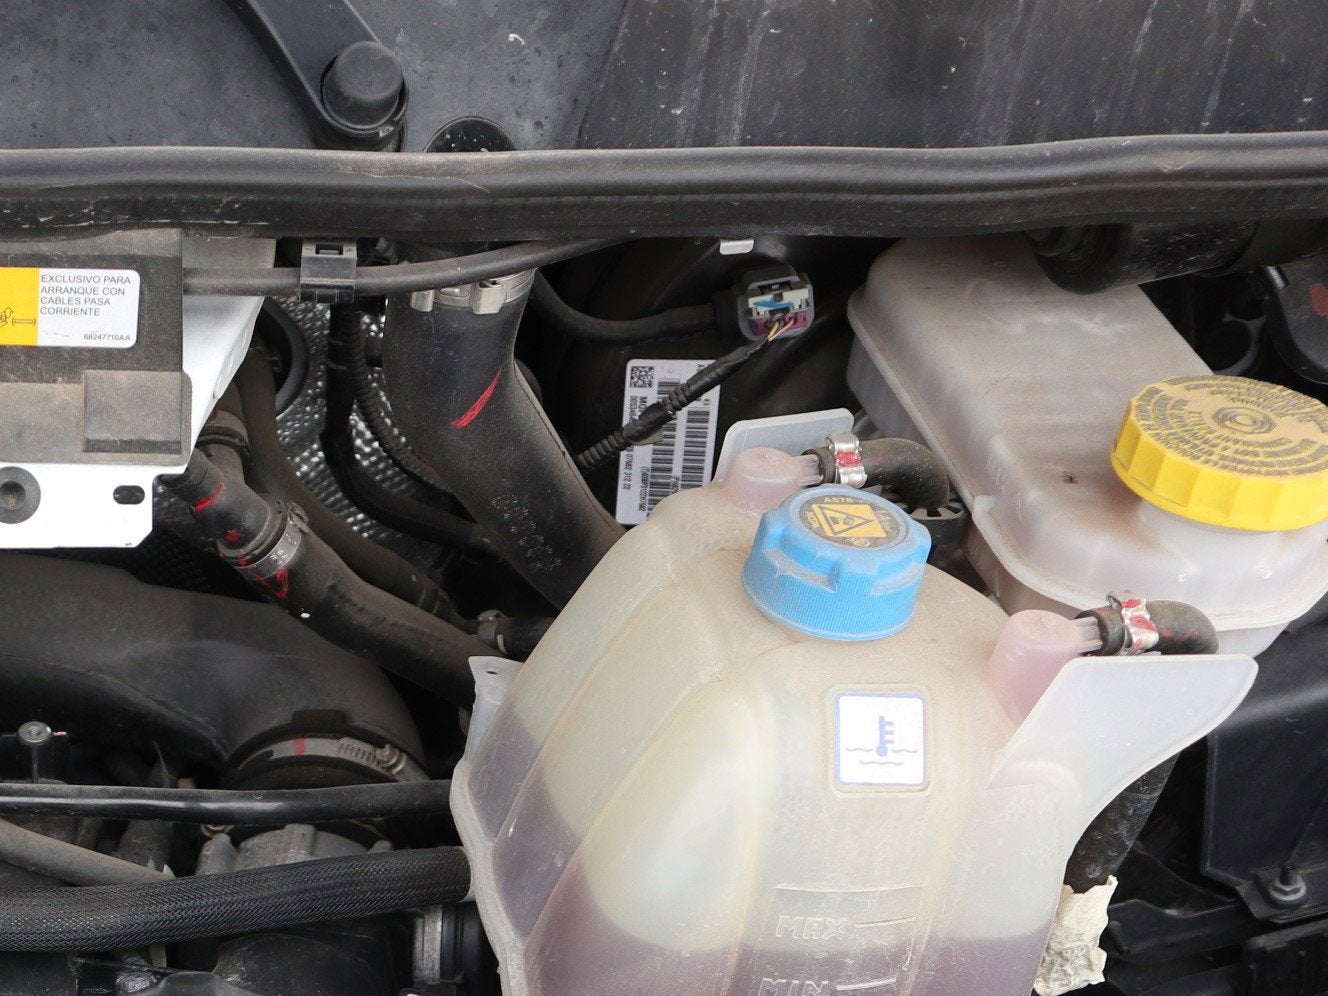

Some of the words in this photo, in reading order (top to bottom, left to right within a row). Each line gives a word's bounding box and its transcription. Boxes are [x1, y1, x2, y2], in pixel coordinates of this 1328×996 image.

[40, 274, 101, 284] EXCLUSIVO
[103, 275, 131, 284] PARA
[40, 286, 99, 295] ARRANQUE
[102, 287, 126, 296] CON
[40, 296, 81, 305] CABLES
[83, 297, 111, 306] PASA
[39, 306, 101, 316] CORRIENTE
[83, 333, 131, 341] 68247710AA
[775, 914, 848, 940] MAX
